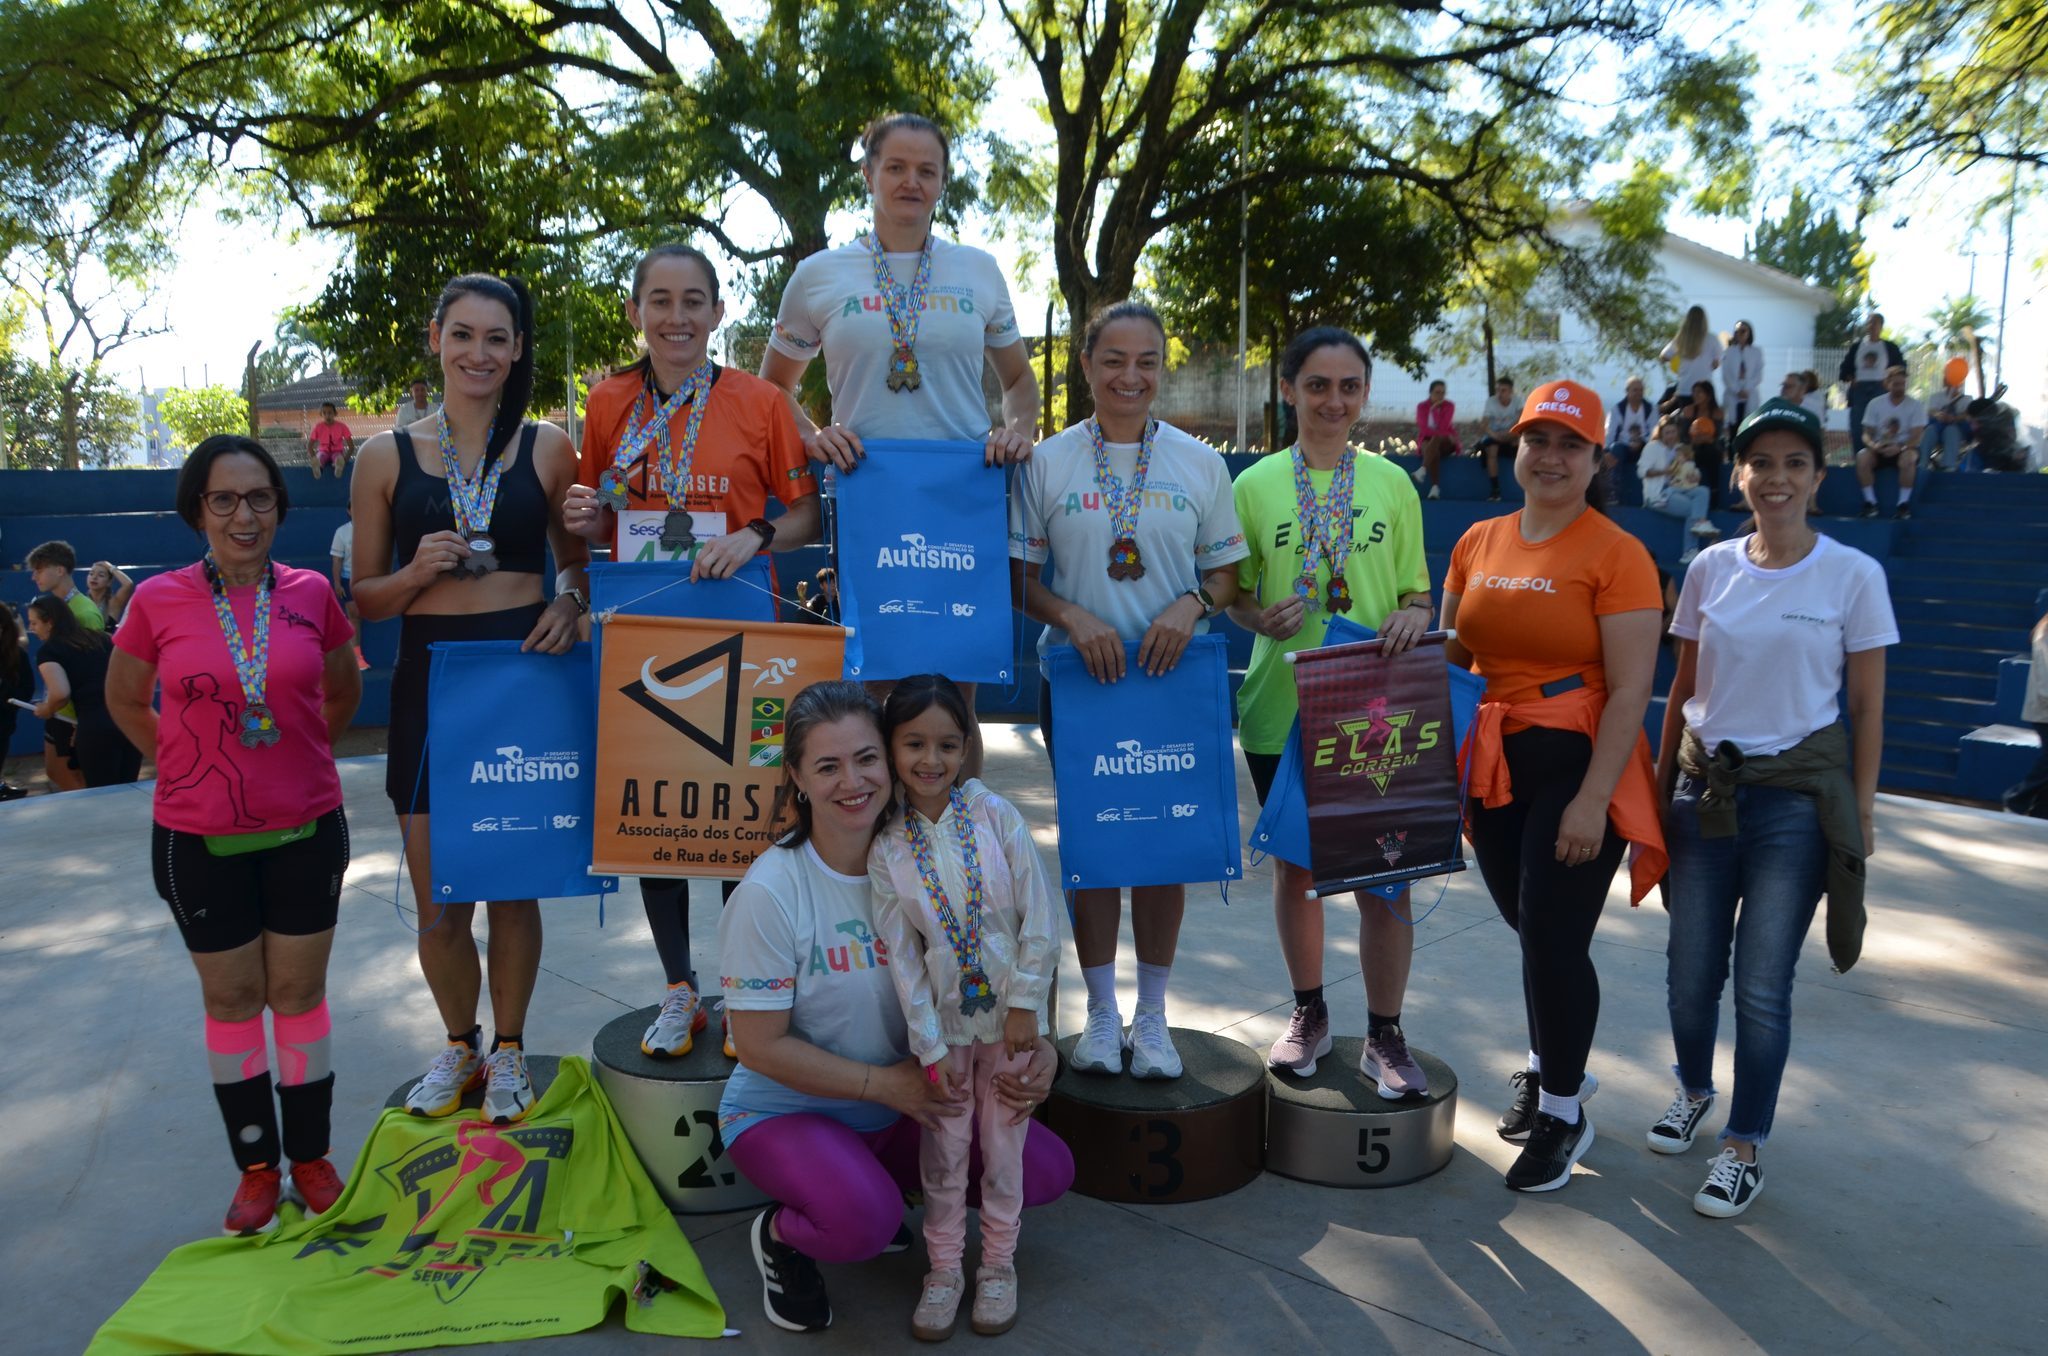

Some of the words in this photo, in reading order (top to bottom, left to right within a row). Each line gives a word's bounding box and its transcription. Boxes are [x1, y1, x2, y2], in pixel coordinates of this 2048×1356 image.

[1535, 402, 1583, 417] CRESOL
[1065, 491, 1187, 516] Aumo
[1275, 520, 1387, 549] ES
[876, 546, 976, 571] Autismo
[1485, 575, 1557, 593] CRESOL
[1314, 720, 1442, 768] ELAS
[470, 760, 580, 784] Autismo
[1093, 752, 1196, 776] Autismo
[1339, 753, 1420, 777] CORREM
[617, 822, 698, 841] Associação
[703, 825, 730, 840] dos
[653, 847, 672, 861] de
[677, 849, 704, 863] Rua
[709, 849, 728, 864] de
[674, 1109, 736, 1189] 2
[1128, 1119, 1184, 1197] 3
[1356, 1127, 1391, 1175] 5
